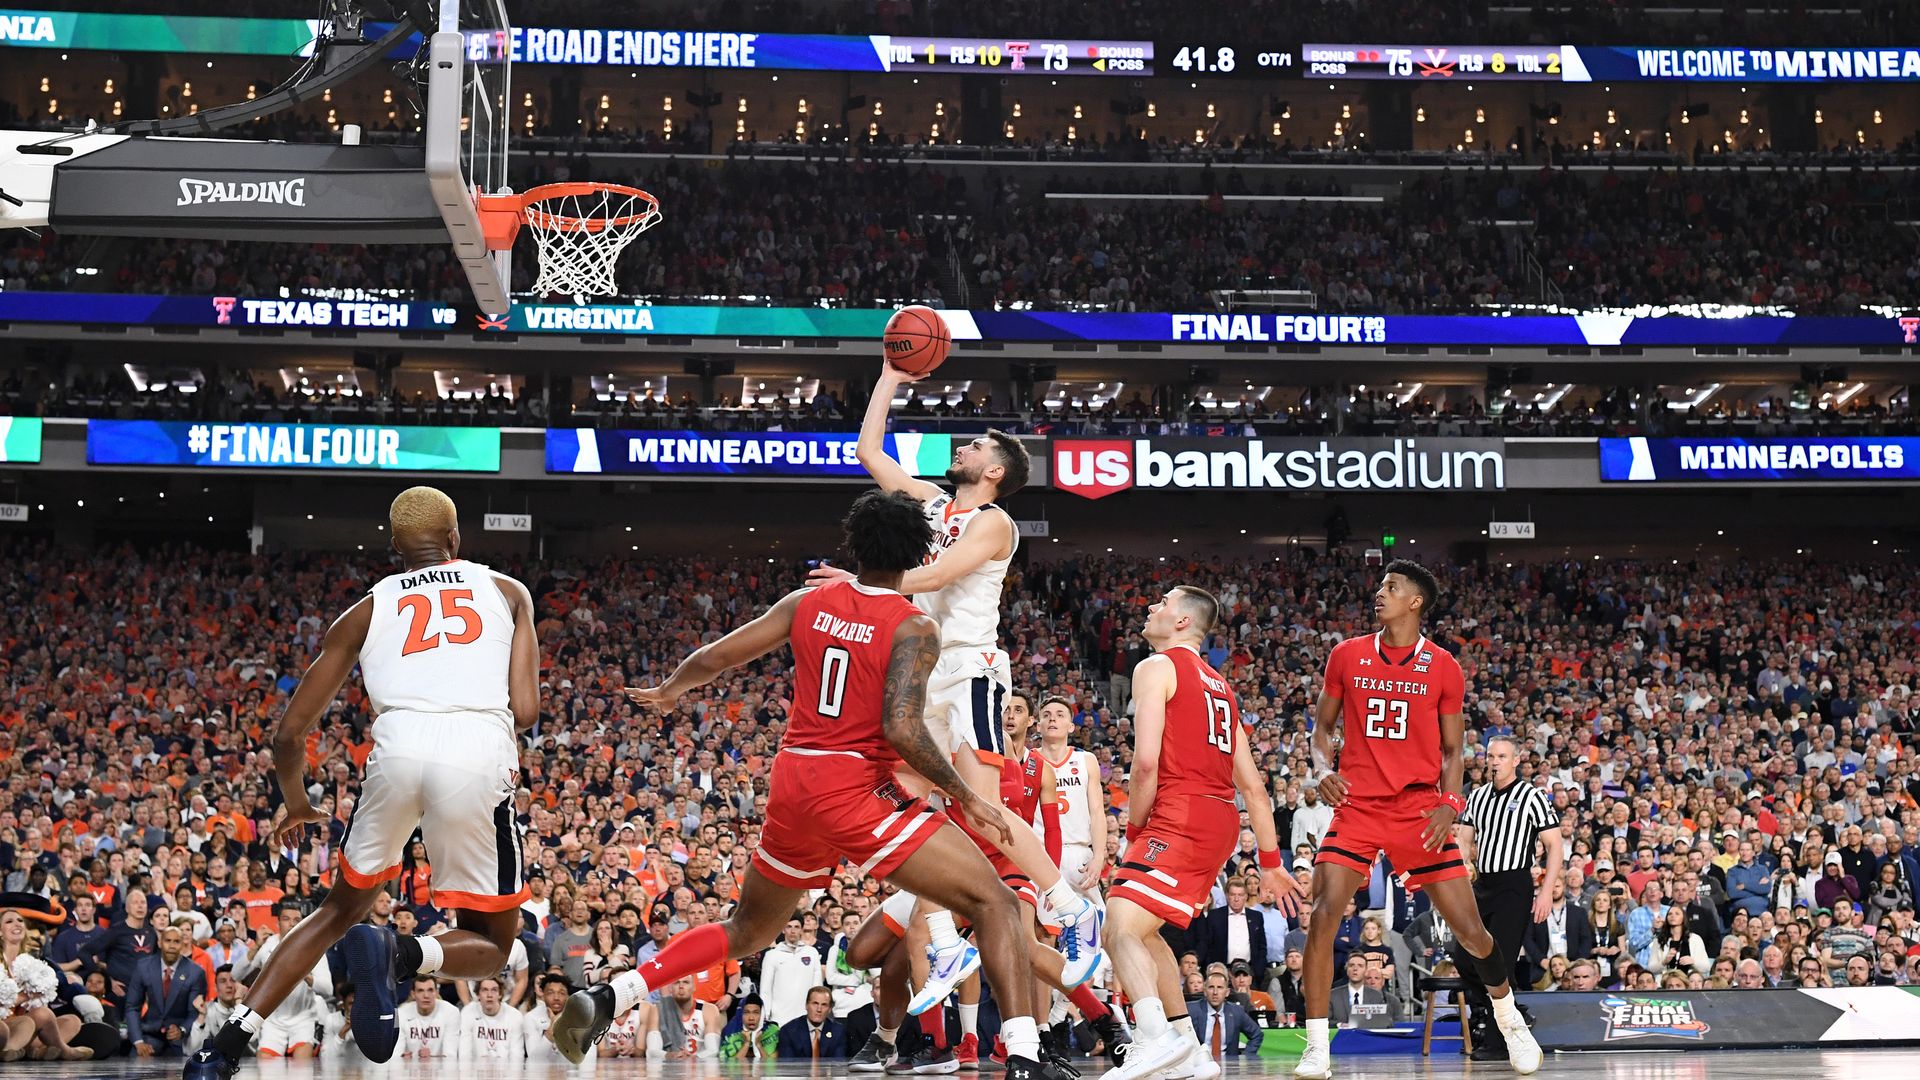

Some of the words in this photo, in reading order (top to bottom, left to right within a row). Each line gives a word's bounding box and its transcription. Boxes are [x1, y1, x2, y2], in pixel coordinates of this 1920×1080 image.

[526, 28, 602, 64] ROAD
[607, 30, 681, 65] ENDS
[684, 32, 757, 67] HERE
[889, 45, 915, 63] TOL
[924, 44, 935, 65] 1
[950, 47, 975, 64] FLS
[976, 45, 1001, 66] 10
[1041, 44, 1069, 71] 73
[1099, 47, 1144, 58] BONUS
[1172, 46, 1235, 73] 41.8
[1311, 50, 1355, 63] BONUS
[1109, 60, 1144, 70] POSS
[1311, 62, 1346, 75] POSS
[1385, 49, 1413, 76] 75
[1459, 55, 1484, 72] FLS
[1490, 54, 1506, 73] 8
[1516, 55, 1542, 73] TOL
[1546, 53, 1560, 74] 2
[1637, 50, 1746, 77] WELCOME
[1749, 50, 1773, 70] TO
[1775, 51, 1920, 78] MINNEA
[177, 178, 305, 206] SPALDING
[242, 300, 333, 325] TEXAS
[336, 302, 409, 327] TECH
[431, 308, 457, 324] VS
[524, 306, 655, 330] VIRGINIA
[1171, 314, 1269, 341] FINAL
[1275, 316, 1362, 342] FOUR
[187, 424, 400, 465] #FINALFOUR
[628, 438, 860, 465] MINNEAPOLIS
[1680, 445, 1904, 470] MINNEAPOLIS
[488, 517, 501, 527] V1
[512, 517, 527, 528] V2
[1493, 525, 1508, 535] V3
[1515, 525, 1530, 535] V4
[400, 570, 464, 590] DIAKITE
[397, 588, 483, 657] 25
[812, 610, 875, 644] EDWARDS
[817, 644, 851, 719] 0
[1353, 676, 1393, 692] TEXAS
[1395, 681, 1428, 696] TECH
[1203, 689, 1232, 755] 13
[1365, 697, 1409, 740] 23
[1612, 1014, 1693, 1025] FOUR
[1613, 1004, 1690, 1015] FINAL
[410, 1026, 441, 1040] FAMILY
[477, 1026, 508, 1041] FAMILY
[687, 1038, 697, 1054] 3
